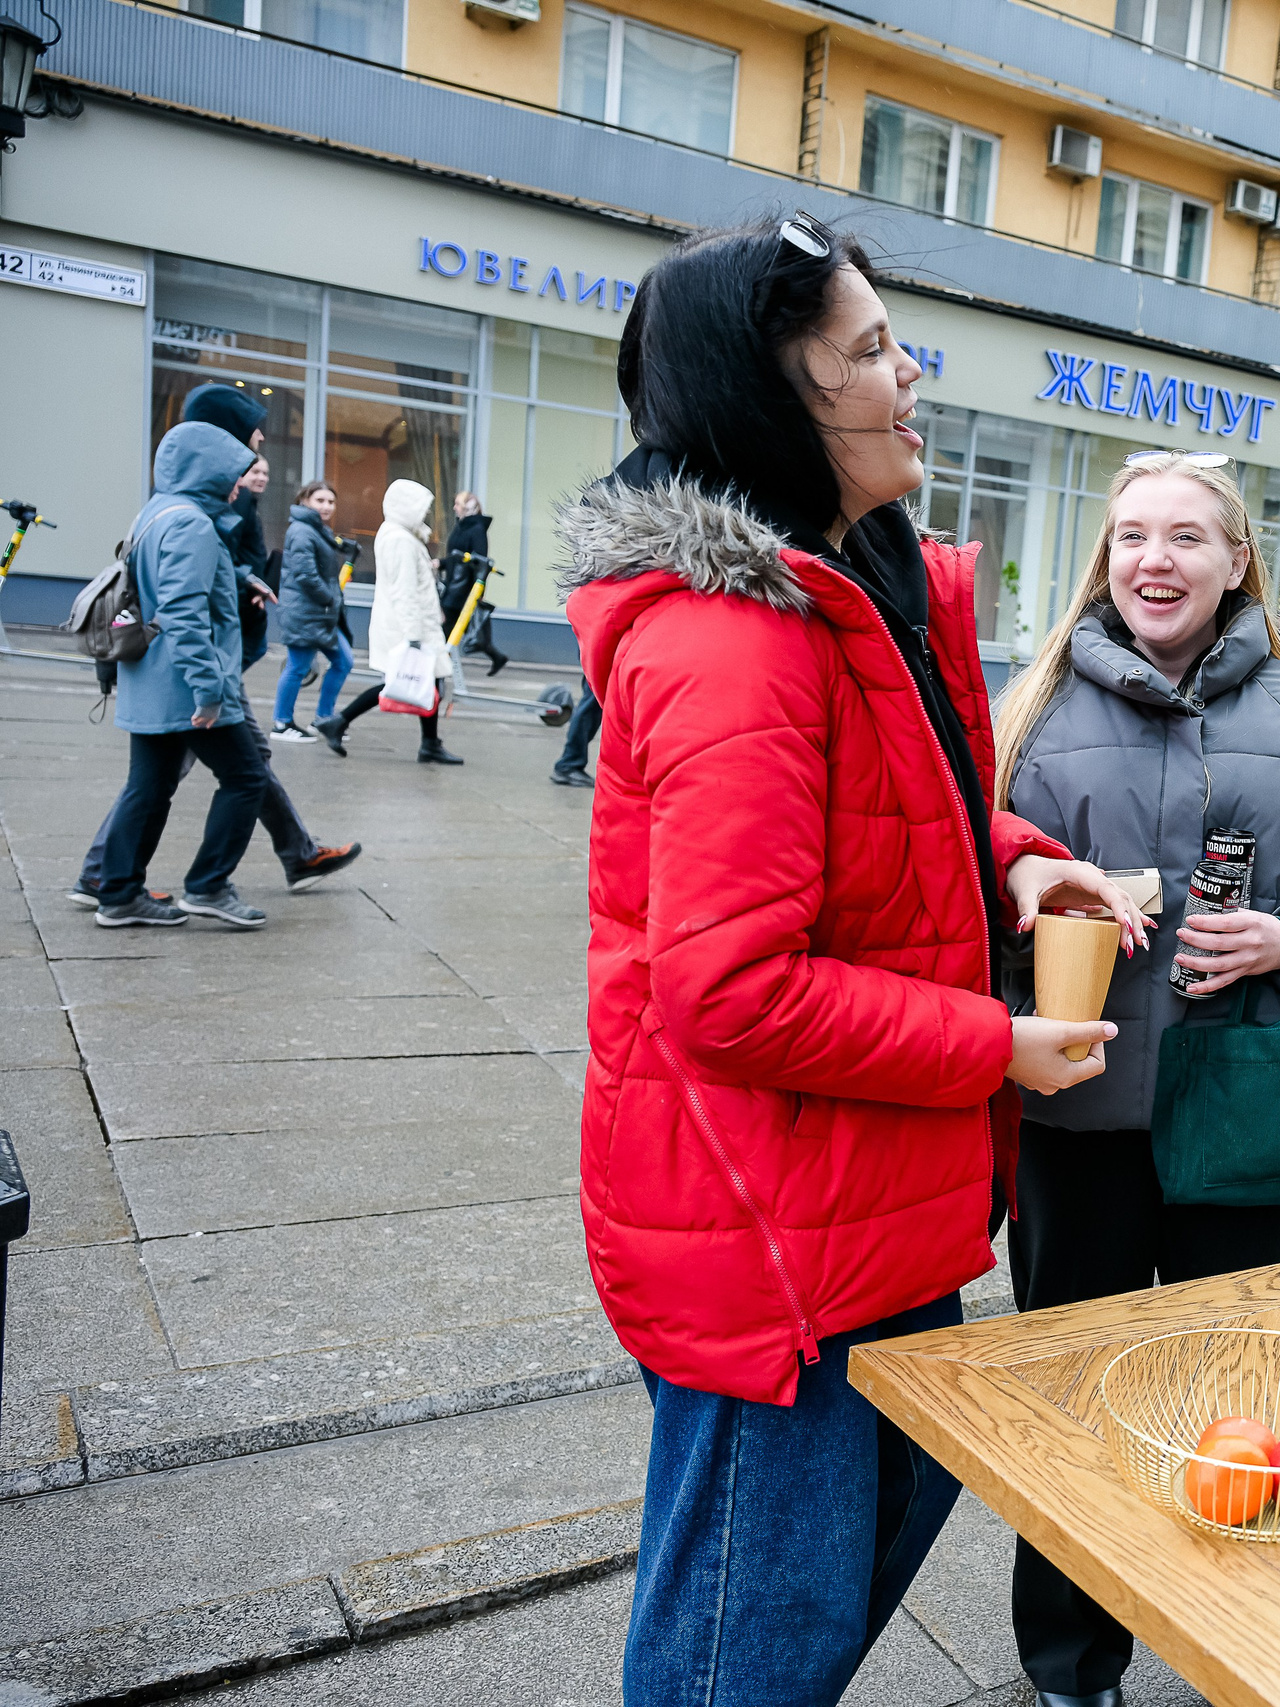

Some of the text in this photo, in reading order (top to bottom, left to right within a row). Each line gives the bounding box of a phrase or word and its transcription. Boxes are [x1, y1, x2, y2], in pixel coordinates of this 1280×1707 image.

[38, 271, 54, 281] 42
[1037, 349, 1278, 443] ЖЕМЧУГ
[1206, 841, 1244, 855] TORNADO
